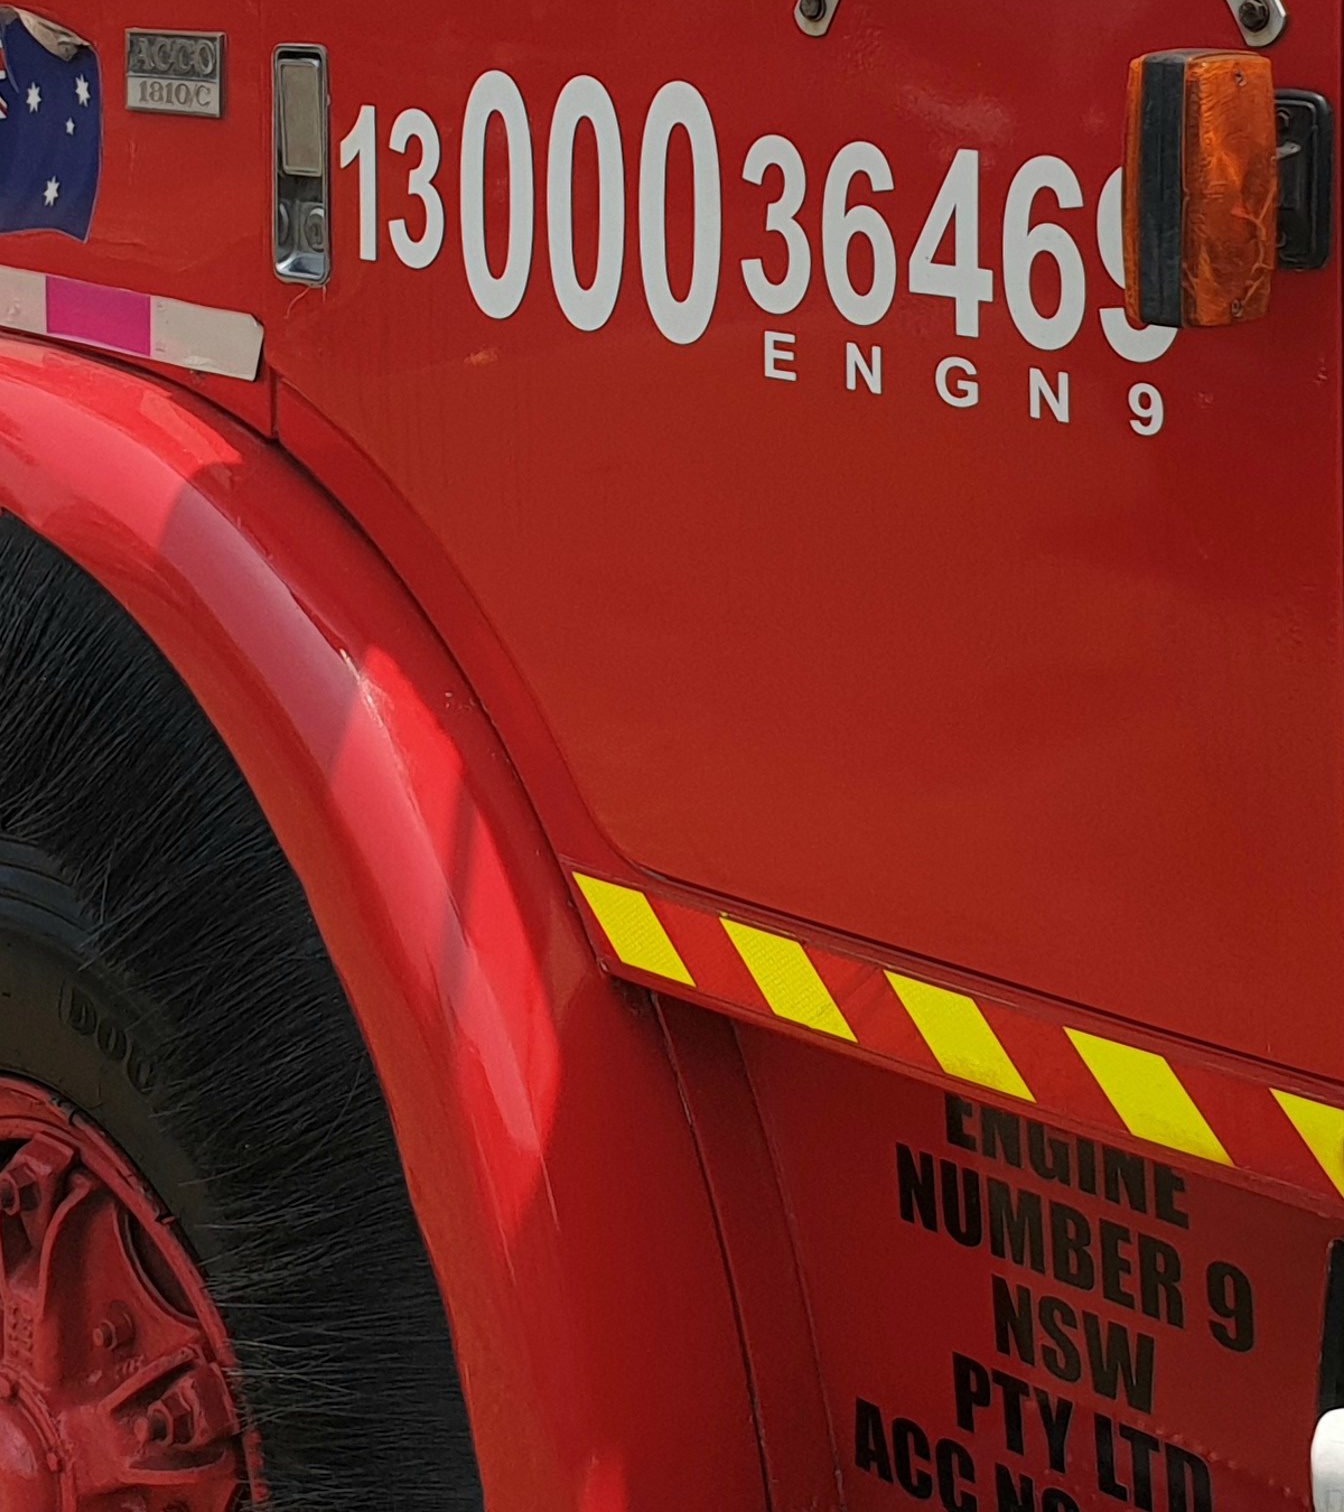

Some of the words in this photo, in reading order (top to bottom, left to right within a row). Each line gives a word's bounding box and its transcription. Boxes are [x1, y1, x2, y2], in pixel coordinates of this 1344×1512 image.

[130, 36, 215, 76] ACCO
[944, 1092, 1190, 1230] ENGINE
[895, 1141, 1185, 1330] NUMBER
[1206, 1260, 1255, 1353] 9
[991, 1273, 1155, 1415] NSW
[856, 1396, 978, 1512] ACC
[952, 1351, 1074, 1475] PTY
[1094, 1412, 1213, 1512] LTD
